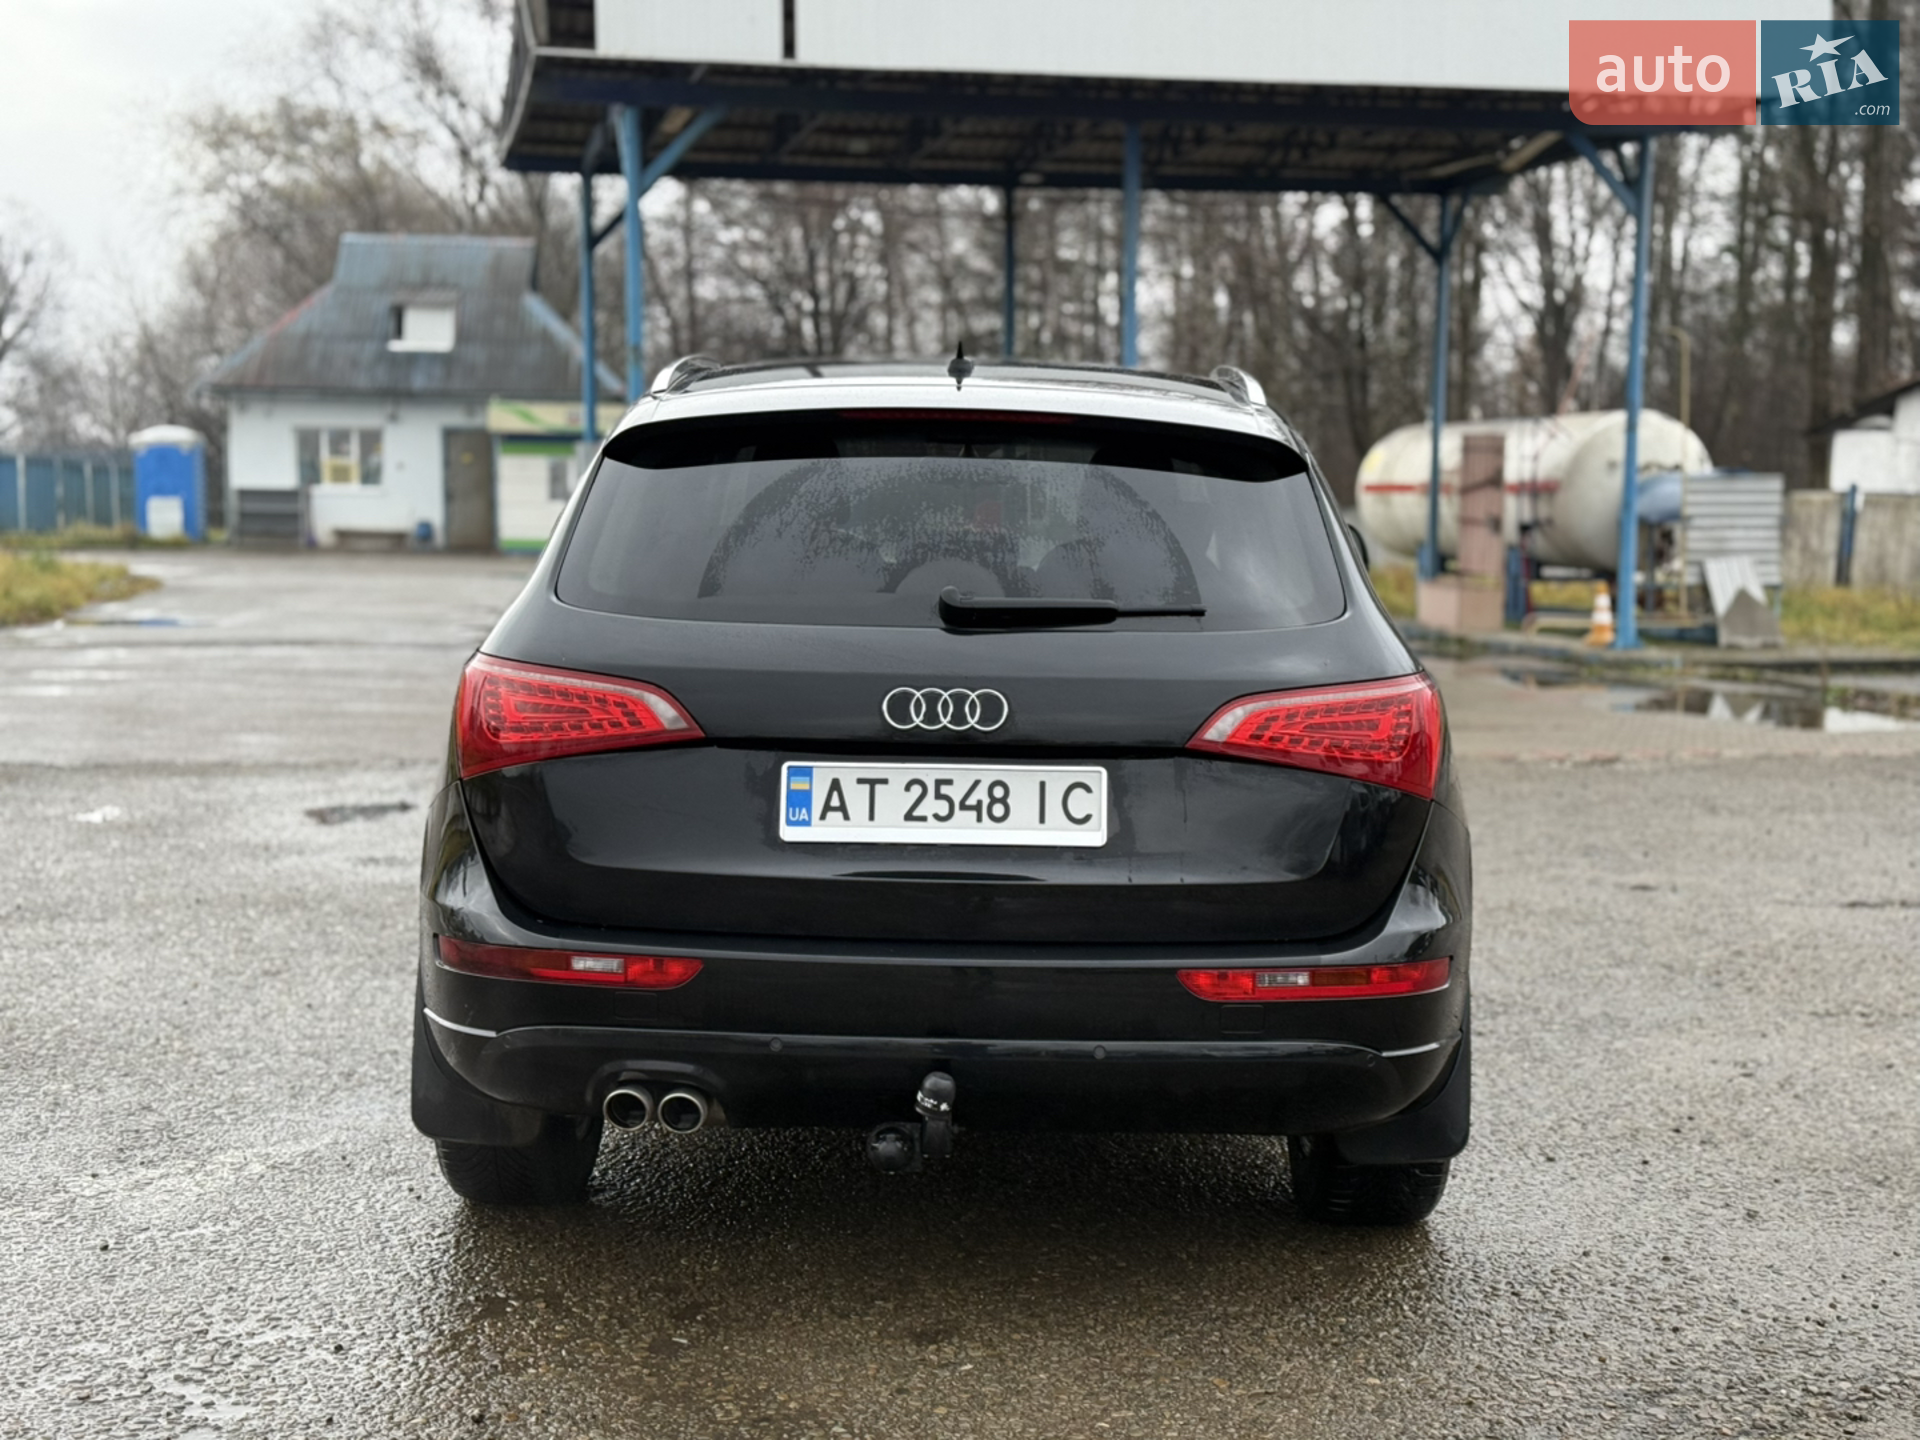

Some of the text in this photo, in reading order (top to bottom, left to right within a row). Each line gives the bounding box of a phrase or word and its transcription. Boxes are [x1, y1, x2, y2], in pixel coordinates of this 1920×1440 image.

[788, 807, 809, 822] UA
[818, 777, 1094, 825] AT 2548 IC
